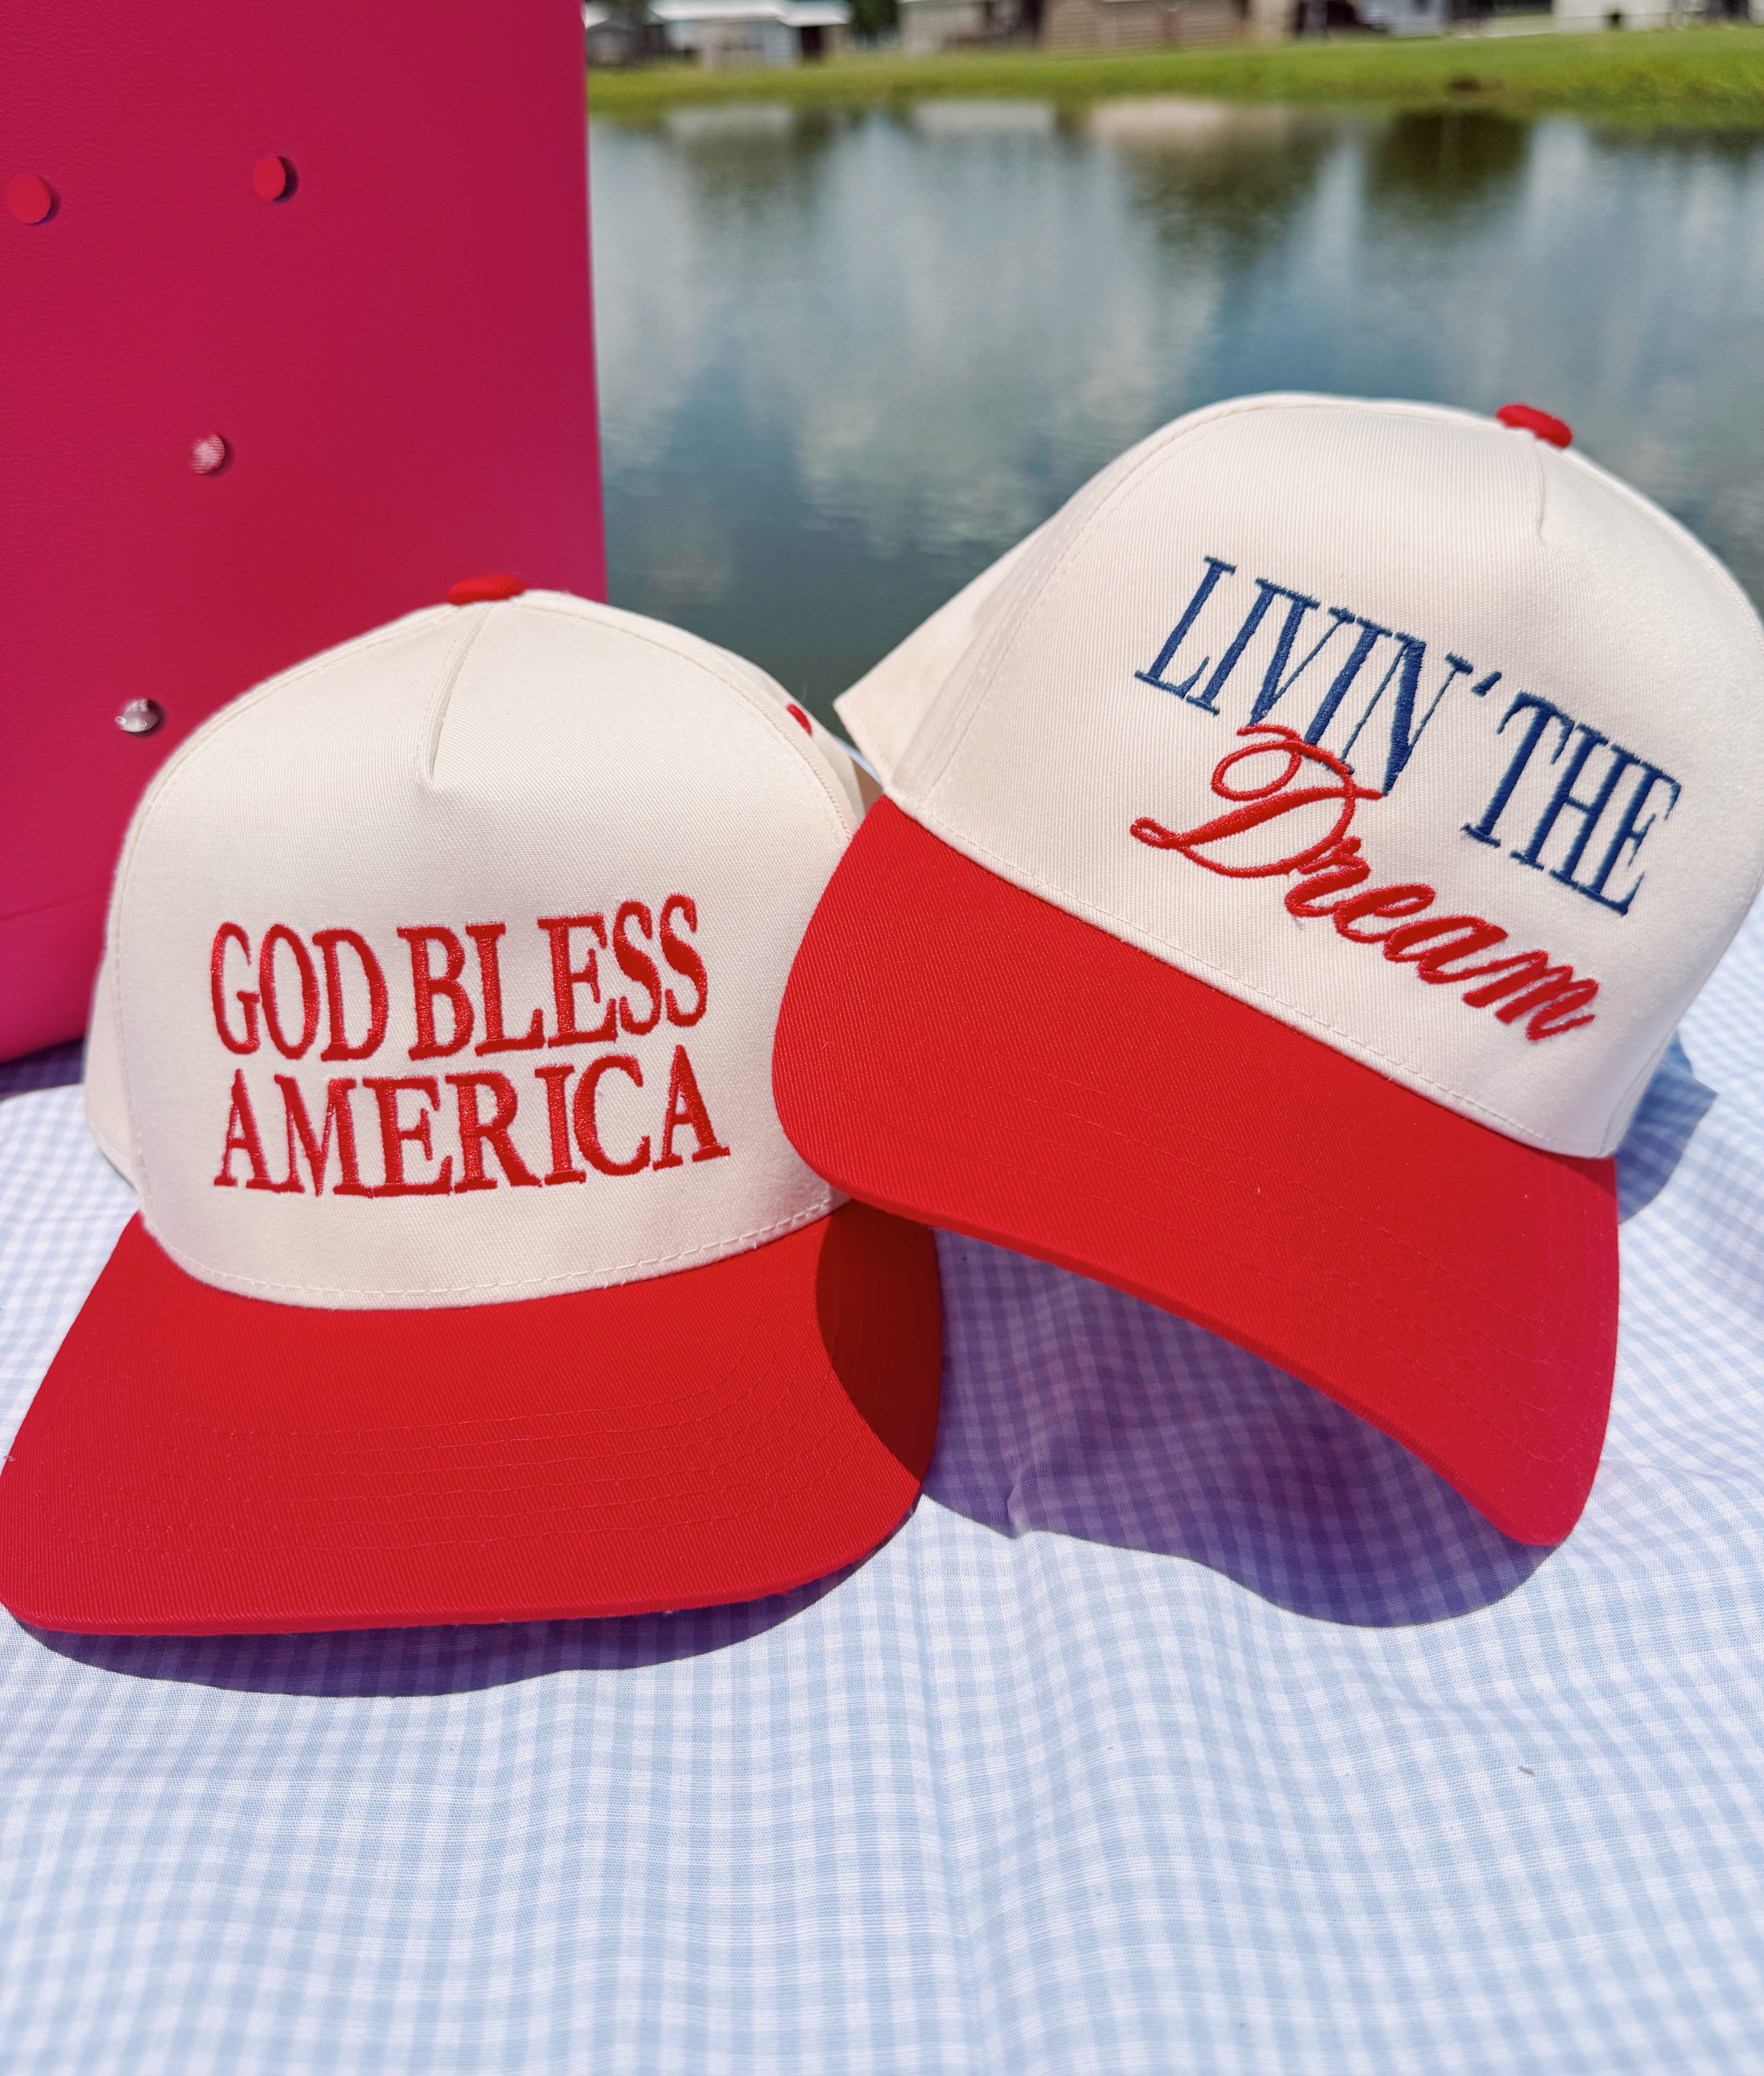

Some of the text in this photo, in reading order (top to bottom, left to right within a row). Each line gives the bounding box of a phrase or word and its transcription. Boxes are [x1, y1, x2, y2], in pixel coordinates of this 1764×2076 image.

[1135, 556, 1681, 916] LIVIN' THE
[211, 894, 708, 1061] GOD BLESS
[1130, 724, 1600, 1041] Dream
[214, 1044, 730, 1198] AMERICA
